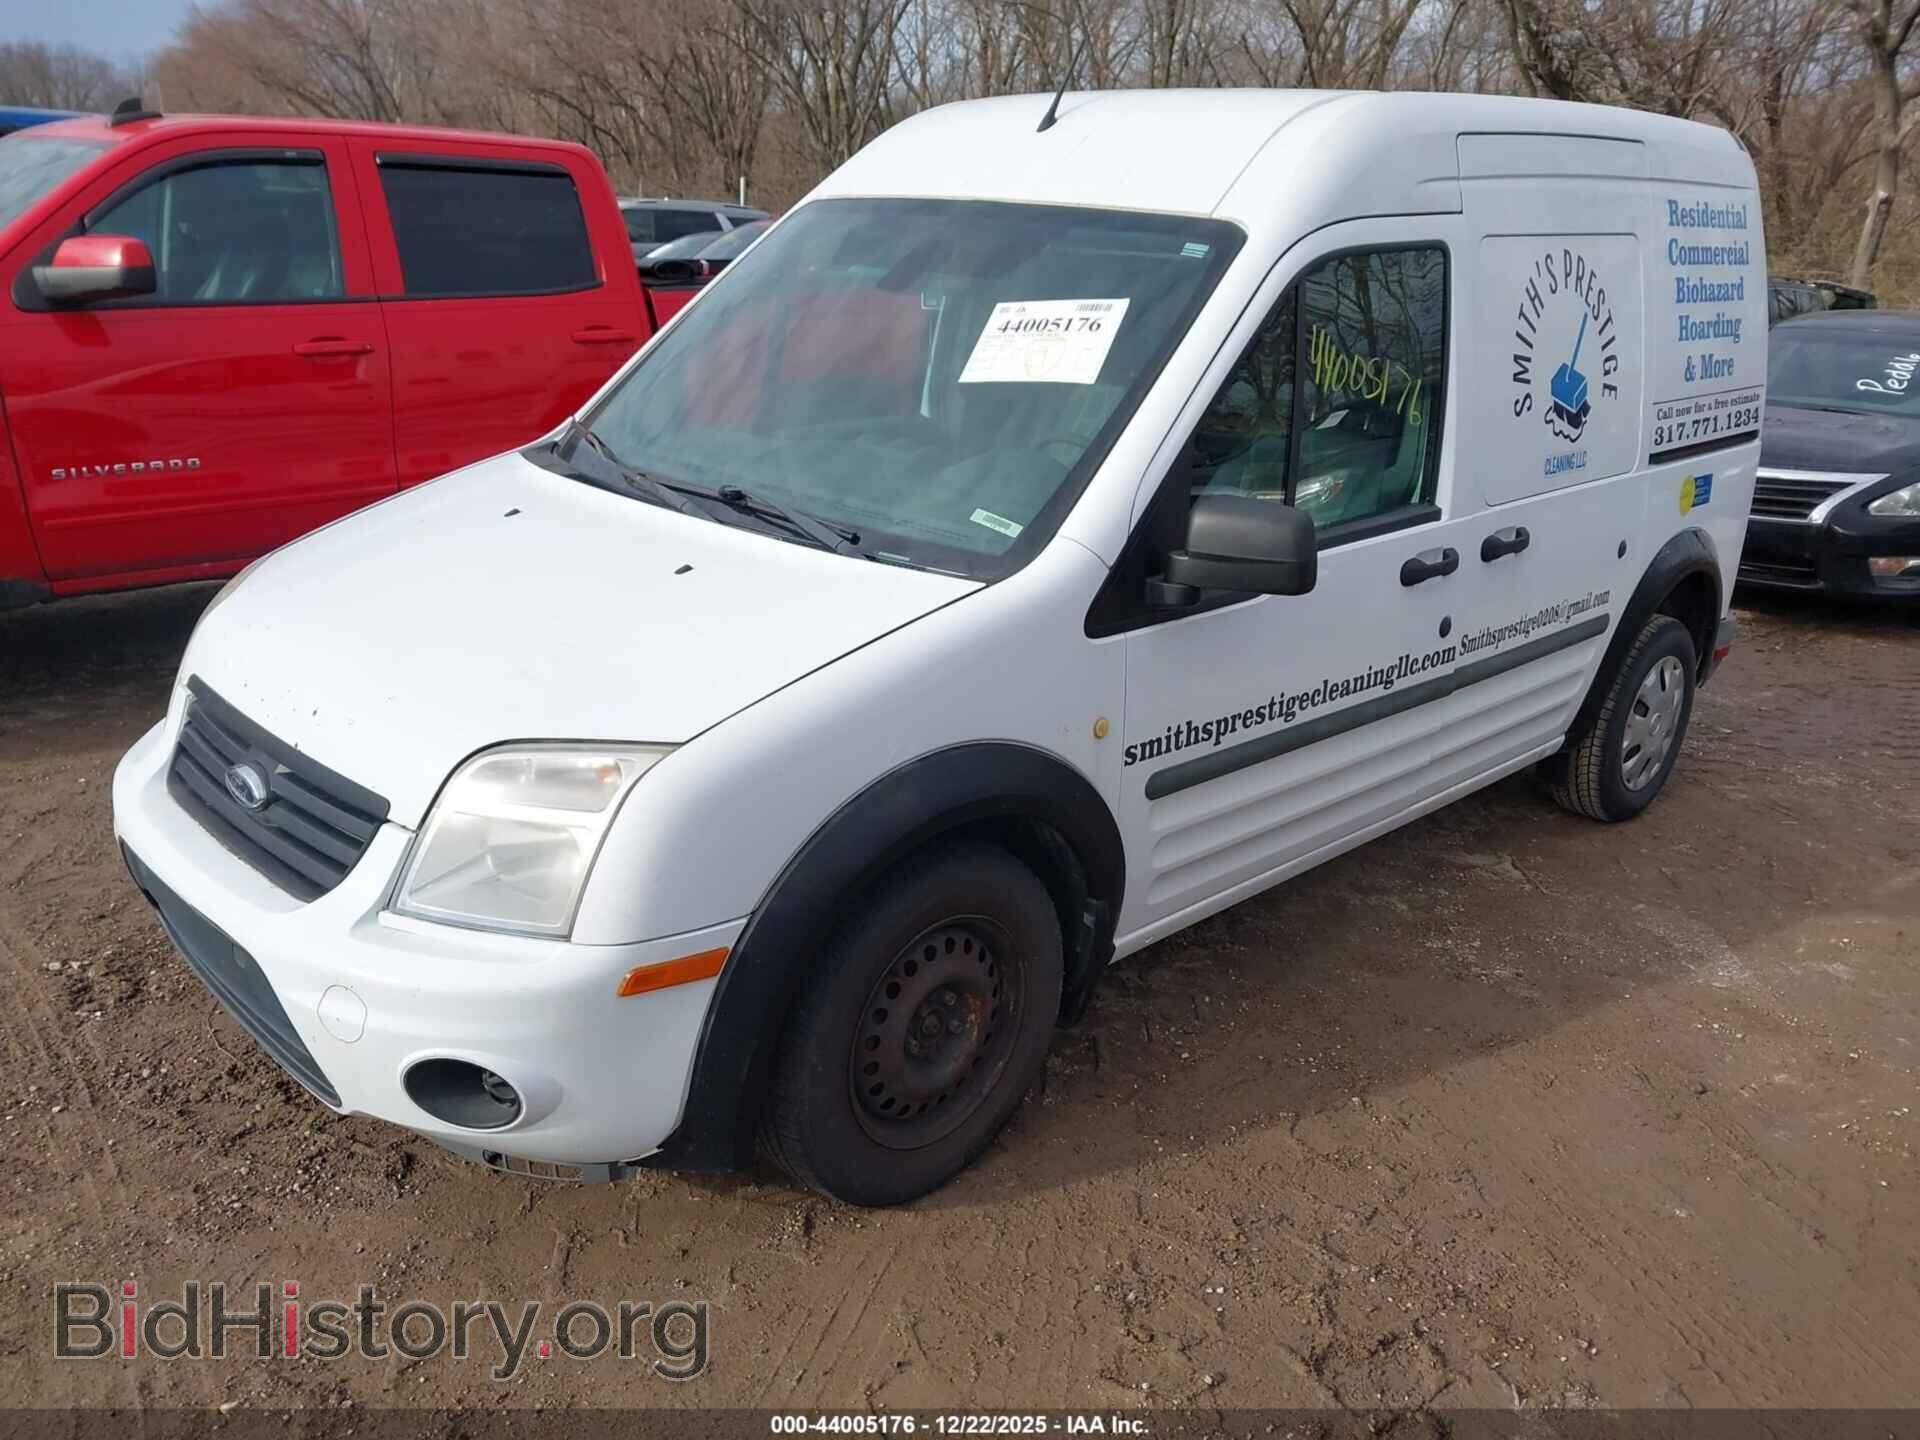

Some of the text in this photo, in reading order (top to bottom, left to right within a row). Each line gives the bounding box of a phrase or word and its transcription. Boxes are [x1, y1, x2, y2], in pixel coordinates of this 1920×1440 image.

[1667, 200, 1748, 229] Residential
[1668, 238, 1750, 266] Commercial
[1675, 276, 1745, 304] Biohazard
[998, 317, 1103, 334] 44005176
[1512, 249, 1619, 417] SMITH'S PRESTIGE
[1678, 312, 1742, 344] Hoarding
[1310, 324, 1422, 425] 44005176
[1684, 354, 1734, 382] & More
[1657, 407, 1673, 421] Call
[1675, 406, 1692, 417] now
[1694, 402, 1705, 413] for
[1714, 398, 1728, 410] free
[1730, 393, 1760, 406] estimate
[1654, 407, 1760, 446] 317.771.1234
[51, 457, 200, 480] SILVERADO
[1544, 453, 1576, 475] CLEANING
[1124, 590, 1610, 766] smithsprestigecleaningllc.com Smithsprestige0208@gmail.com
